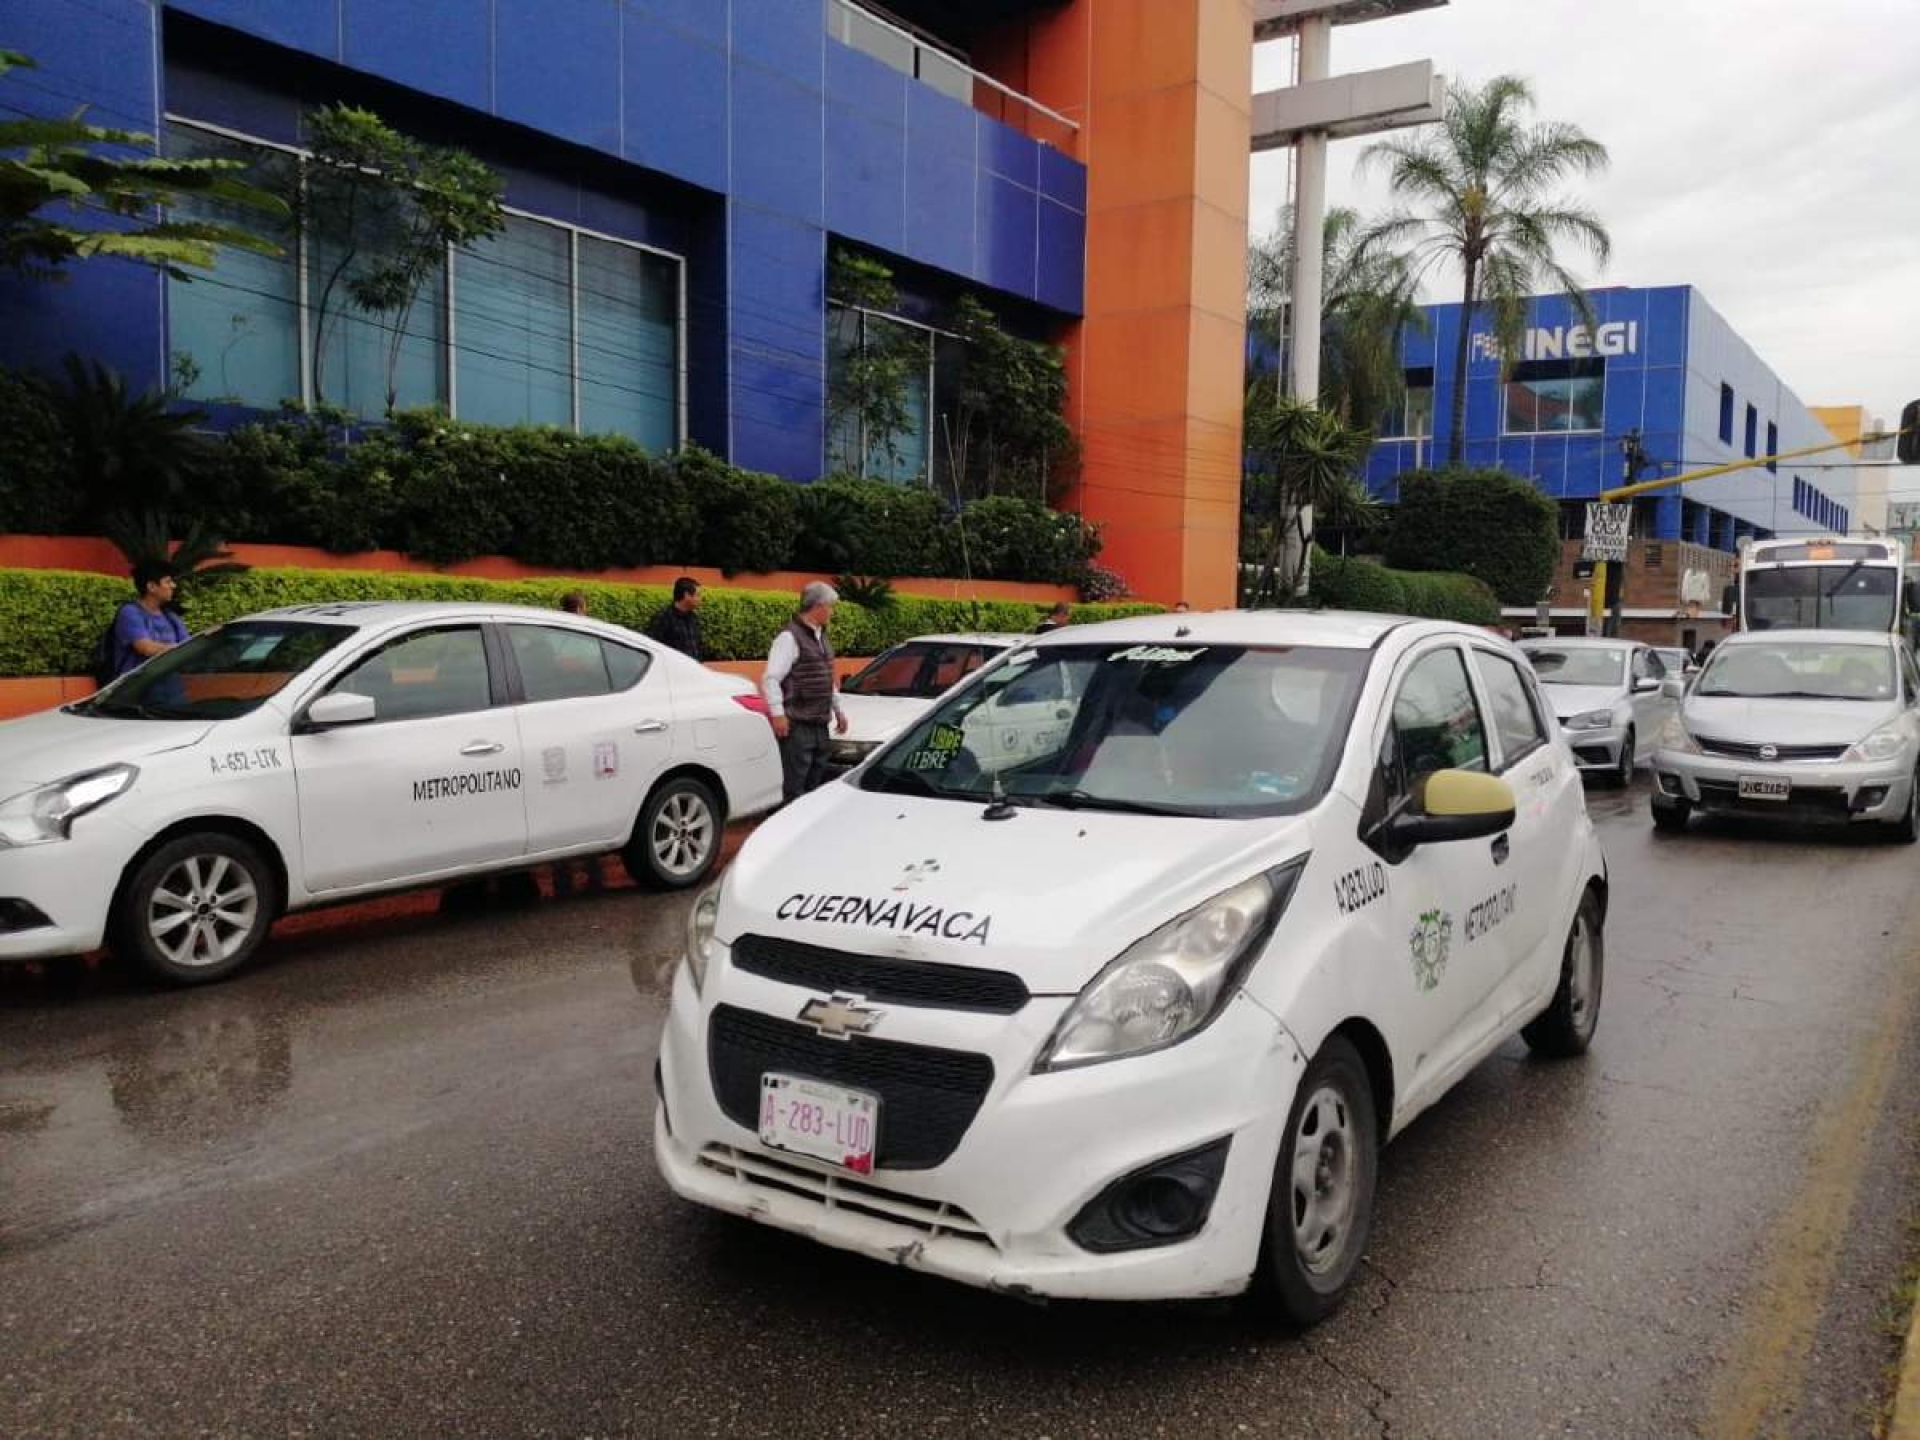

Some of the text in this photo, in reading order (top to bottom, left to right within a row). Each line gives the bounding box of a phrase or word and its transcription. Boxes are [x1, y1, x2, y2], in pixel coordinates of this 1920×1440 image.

[1525, 320, 1637, 360] INEGI
[1591, 521, 1622, 535] CASA
[210, 746, 282, 775] A-652-LTK
[413, 768, 521, 801] METROPOLITANO
[776, 894, 991, 945] CUERNAVACA
[764, 1093, 871, 1153] A-283-LUD
